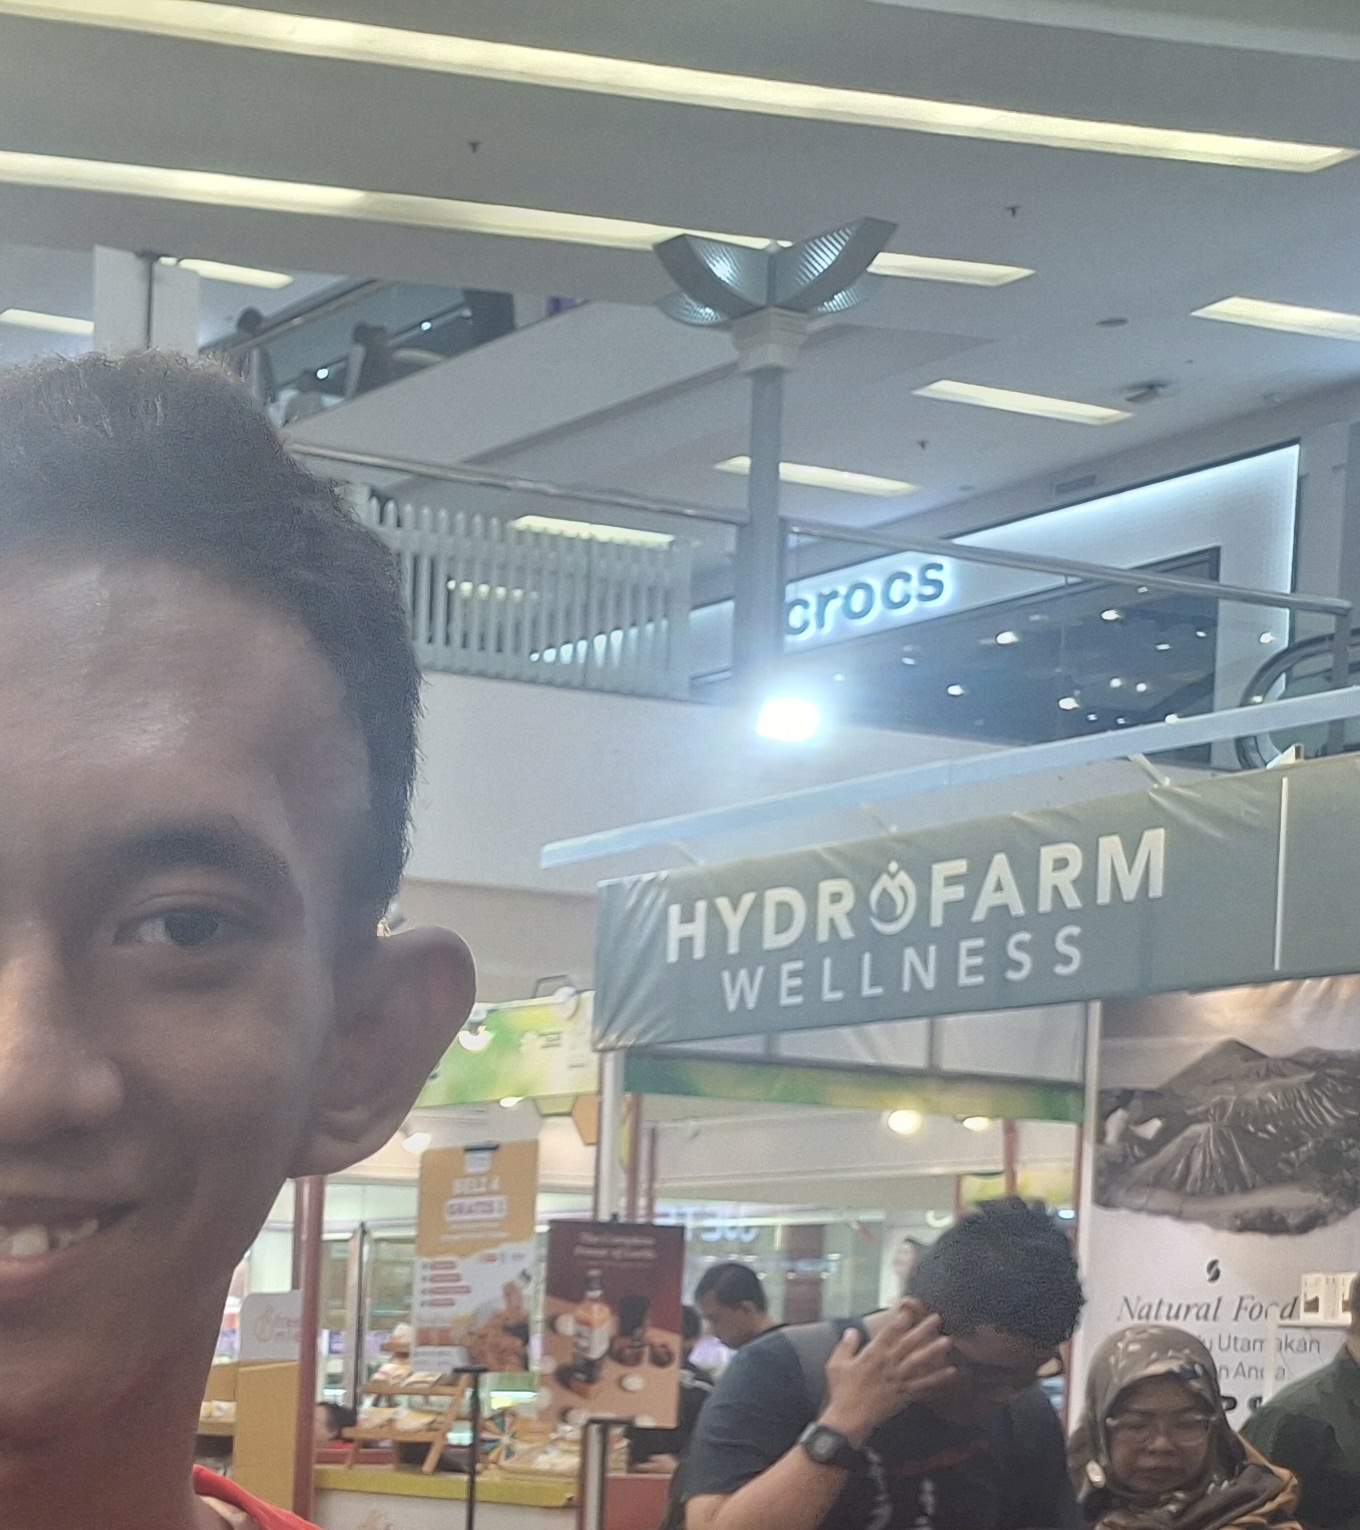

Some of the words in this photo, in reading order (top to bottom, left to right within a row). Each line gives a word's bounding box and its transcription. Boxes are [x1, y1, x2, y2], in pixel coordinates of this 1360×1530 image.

[785, 562, 944, 636] crocs
[666, 826, 1166, 964] HYDROFARM
[721, 924, 1083, 1013] WELLNESS
[1117, 1295, 1223, 1322] Natural
[1218, 1333, 1320, 1354] Utamkan
